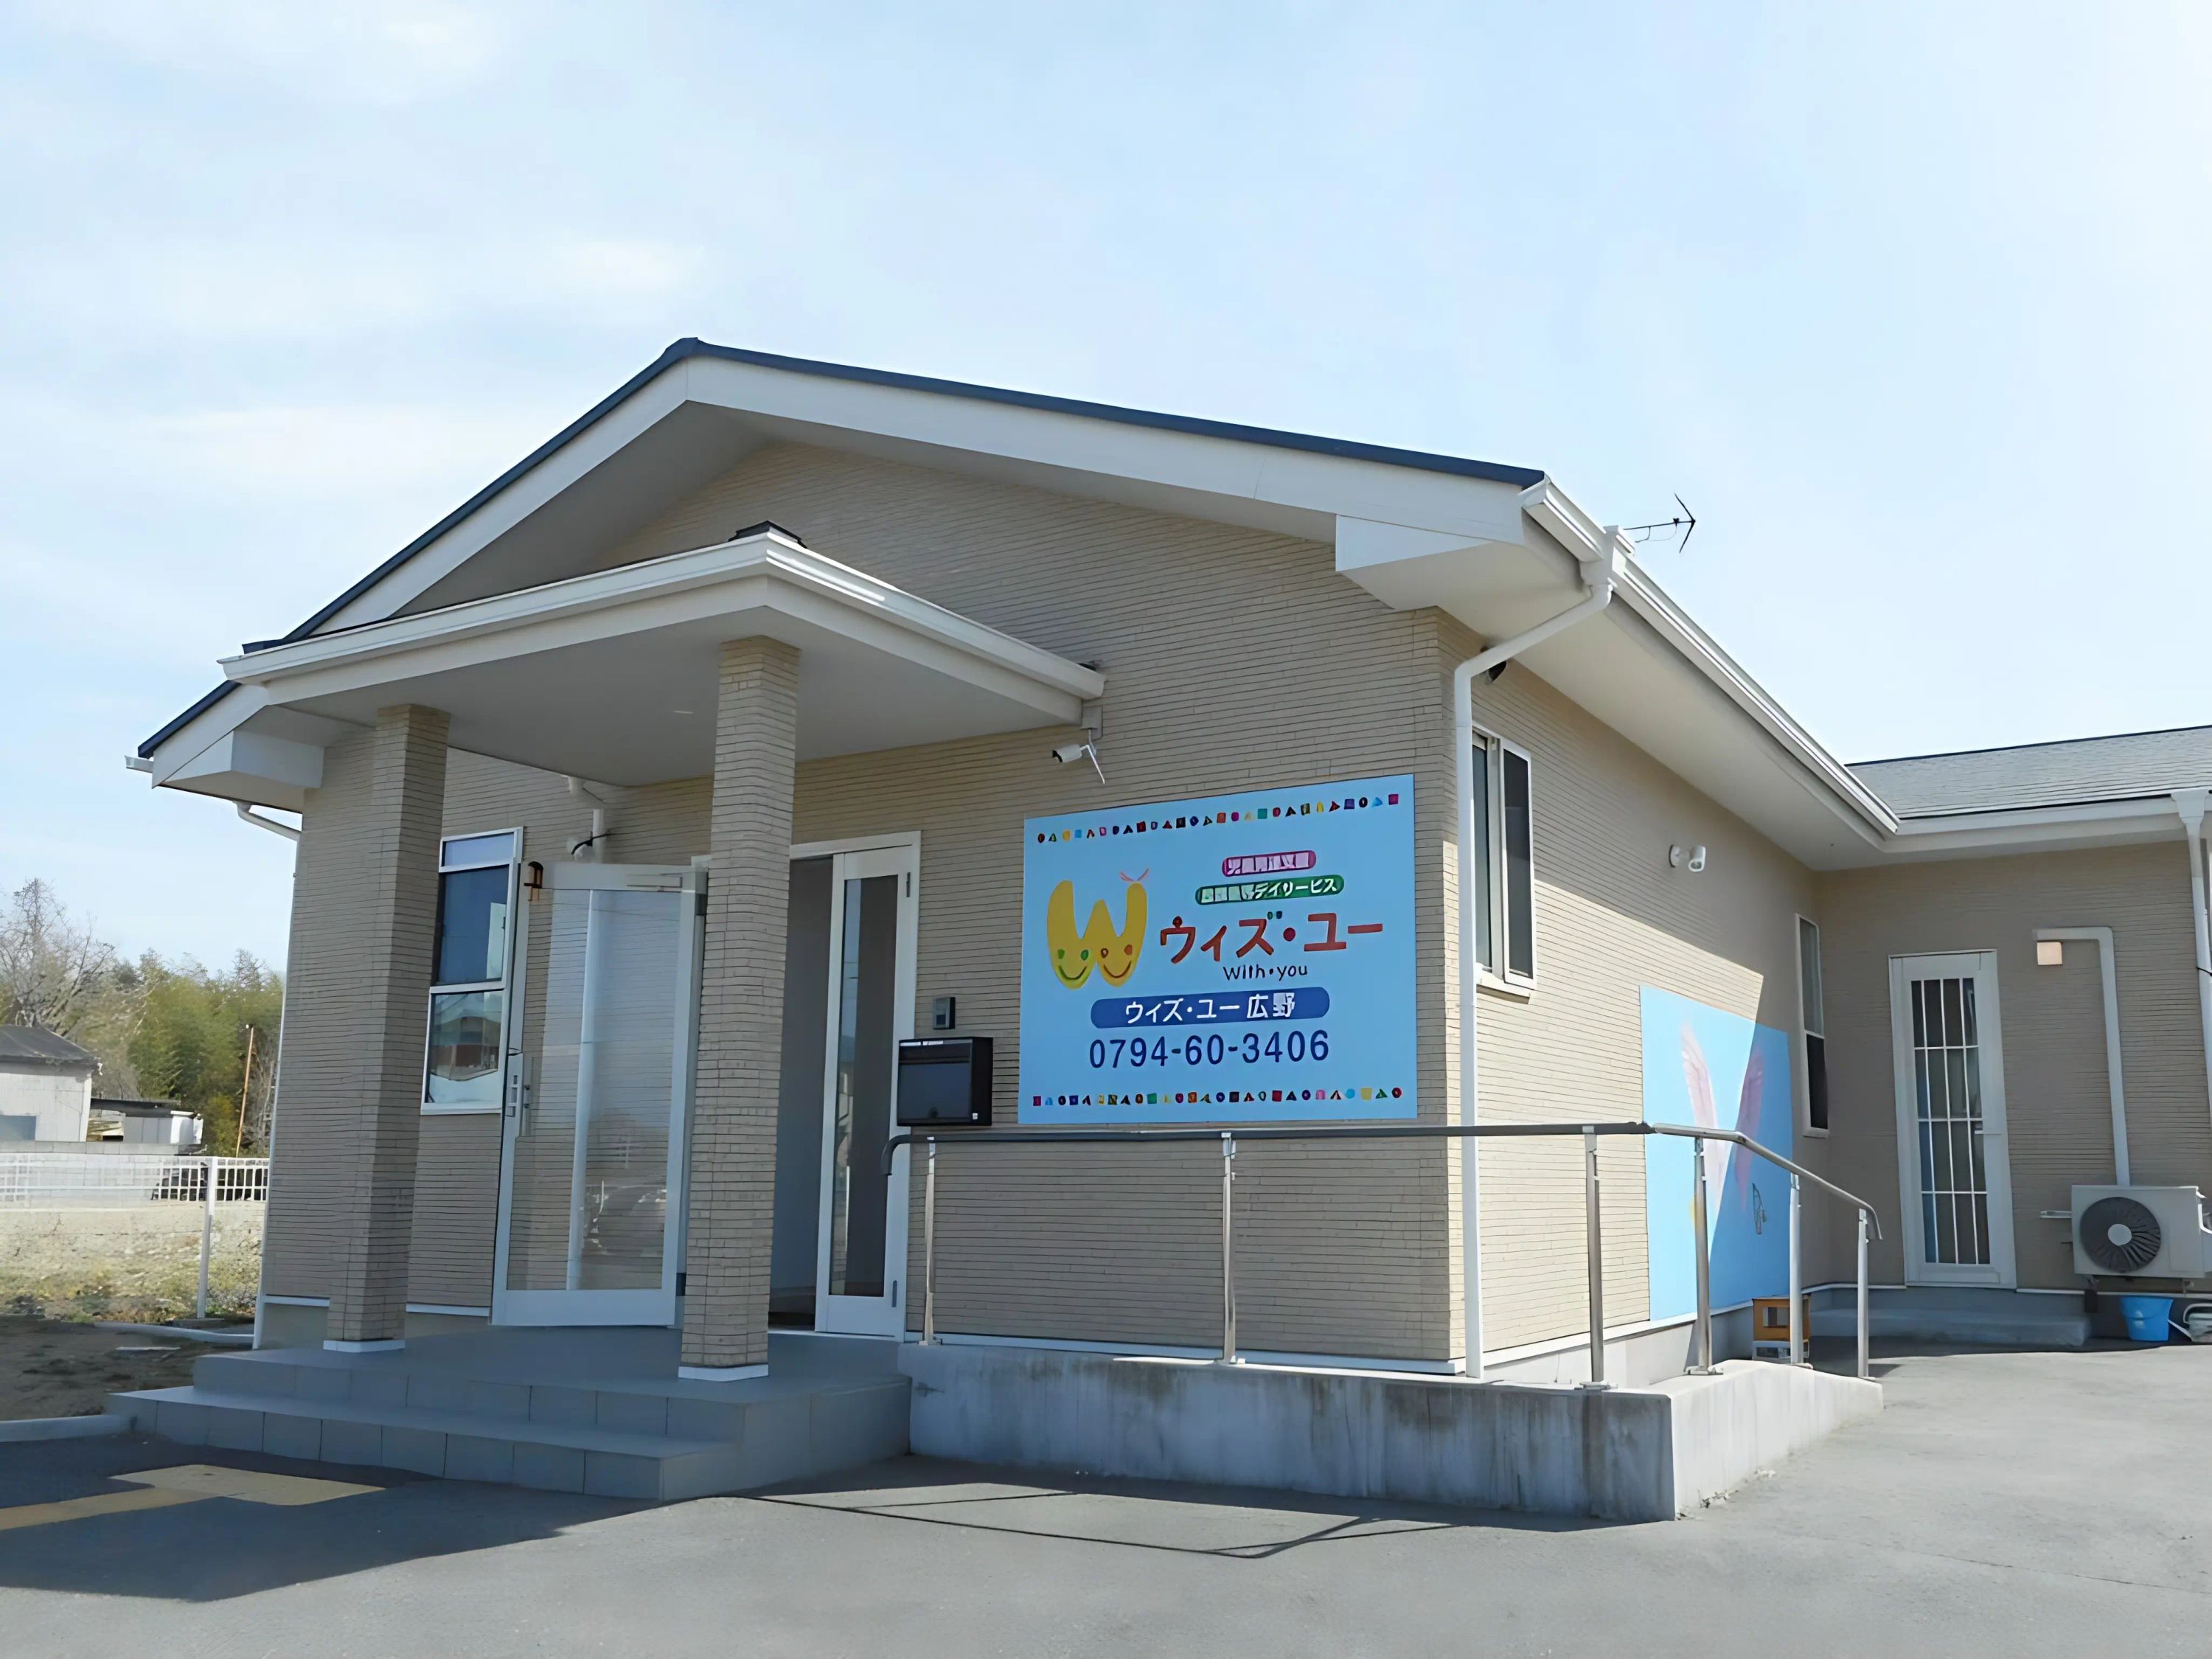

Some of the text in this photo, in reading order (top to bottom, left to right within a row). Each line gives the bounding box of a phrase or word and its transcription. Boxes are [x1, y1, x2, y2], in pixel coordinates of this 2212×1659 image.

[1160, 912, 1383, 964] ウィズ・ユー
[1089, 1029, 1329, 1068] 0794-60-3406
